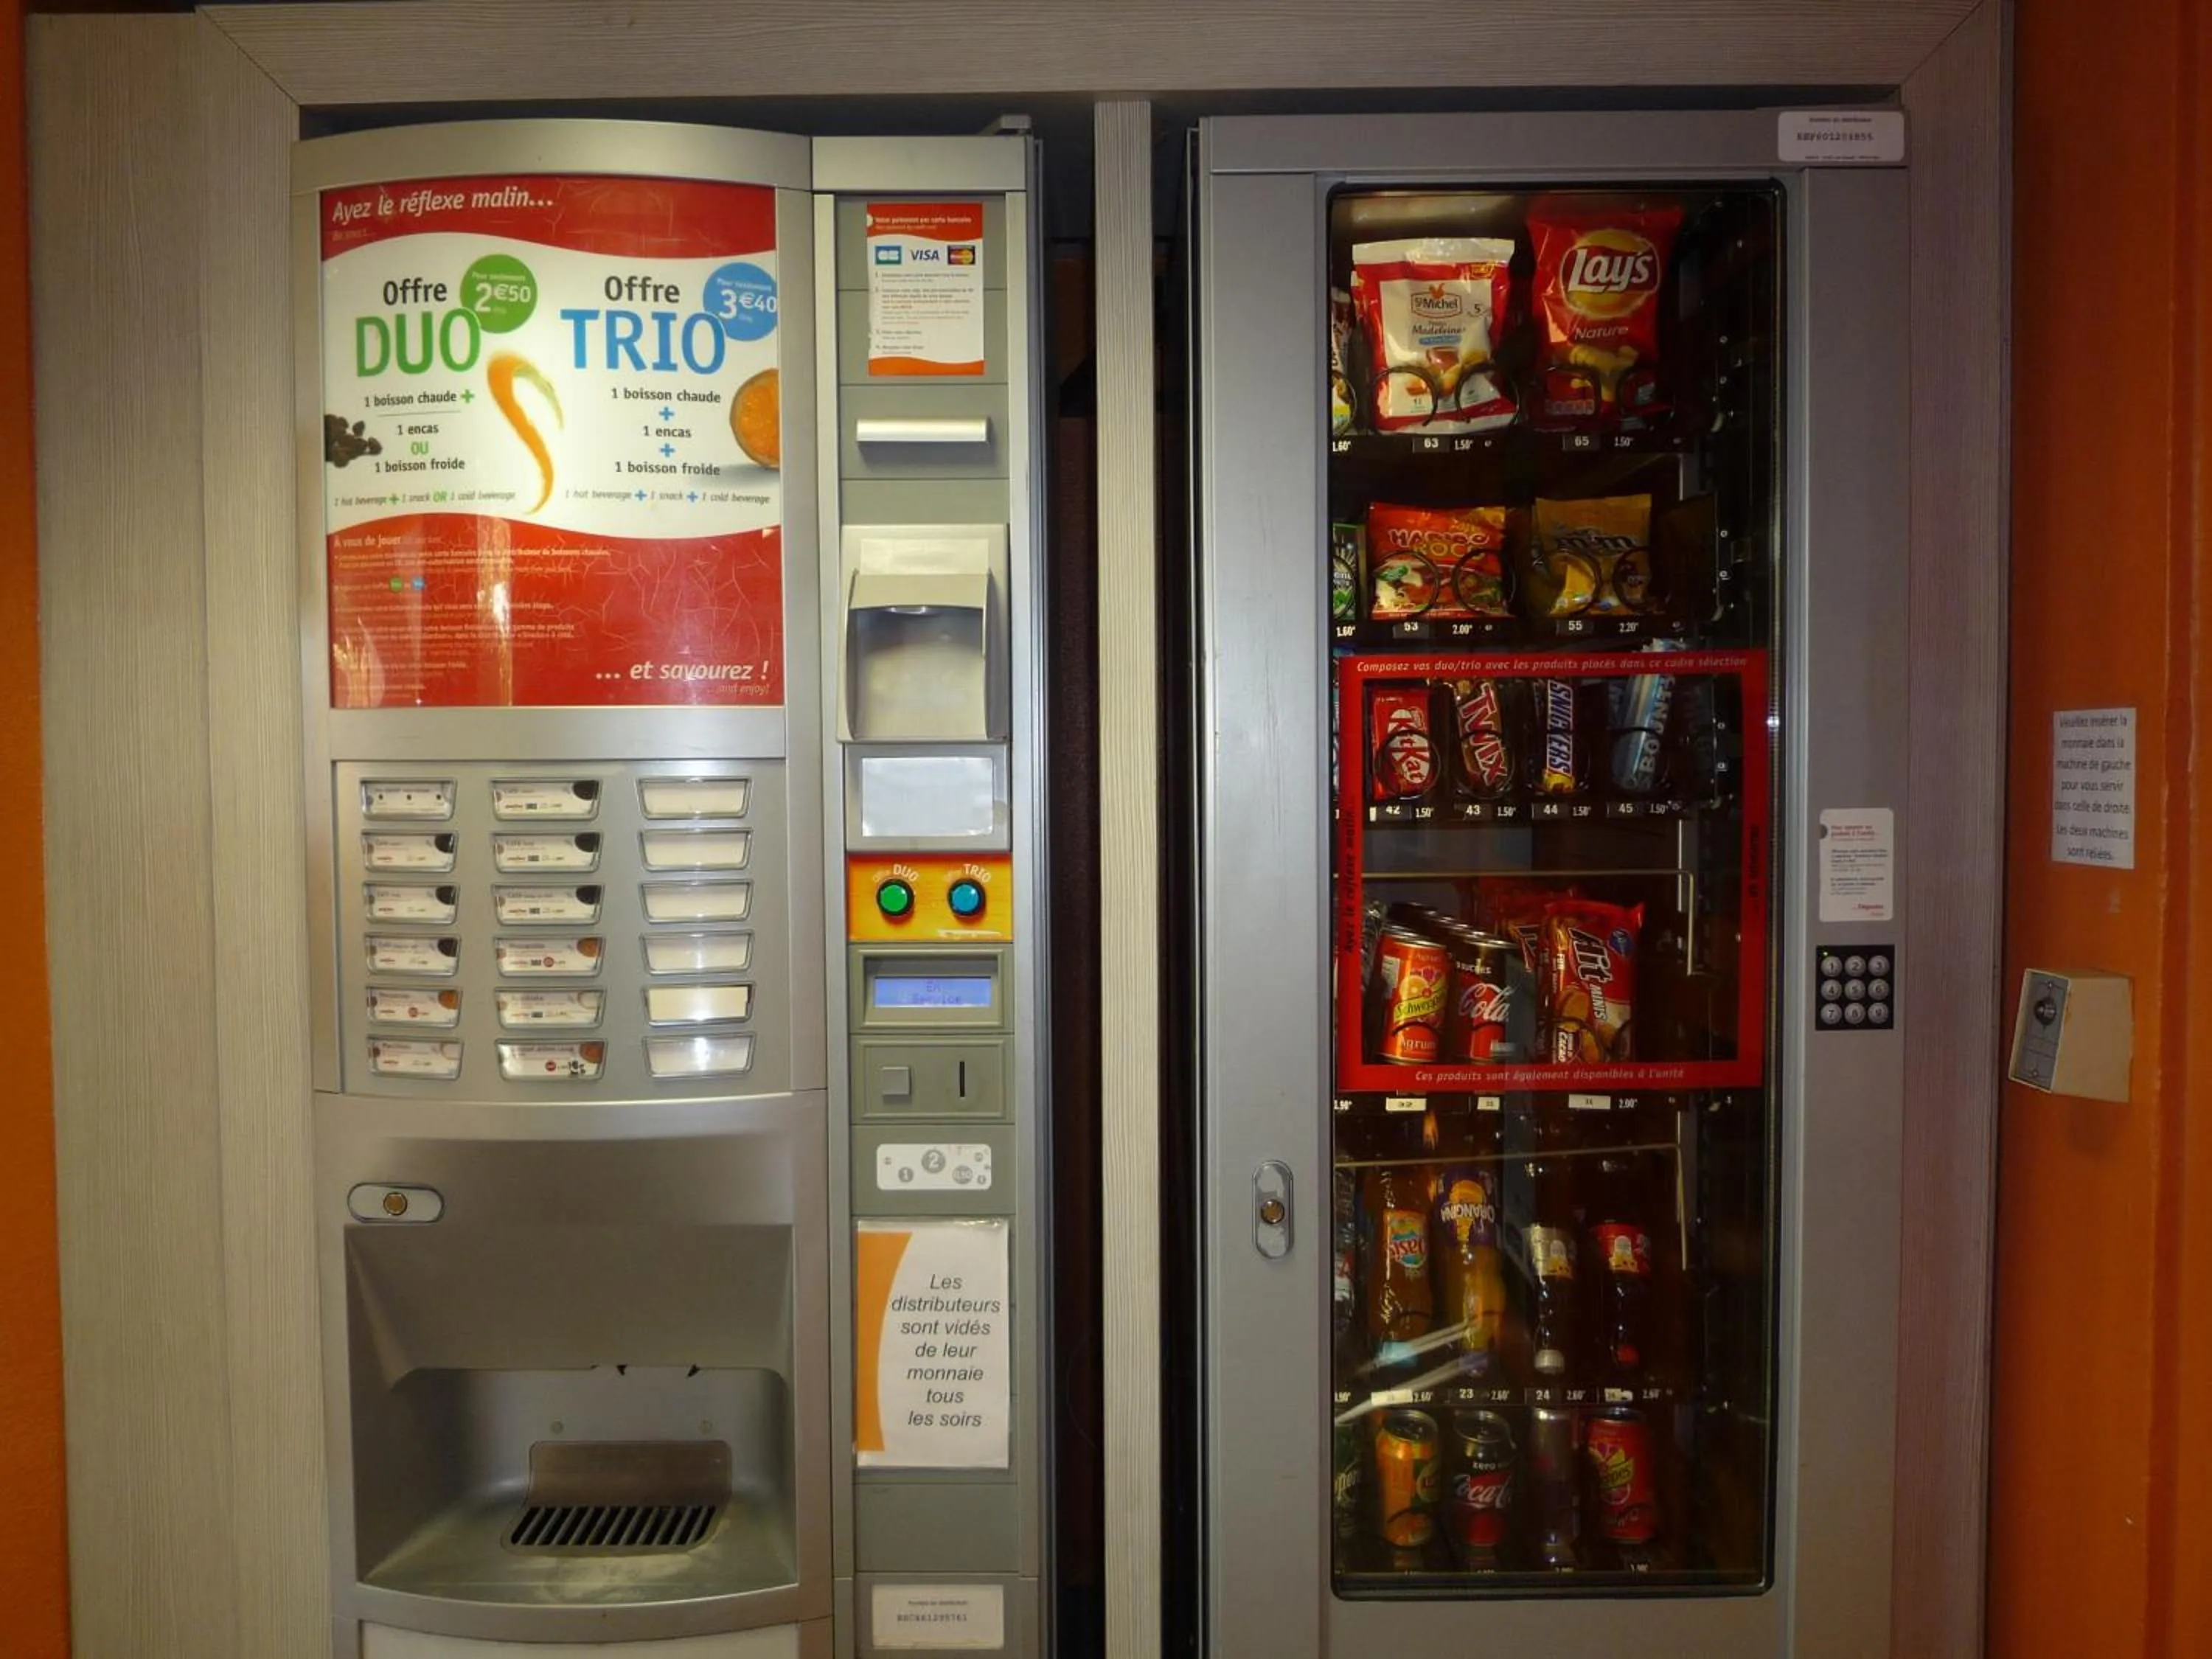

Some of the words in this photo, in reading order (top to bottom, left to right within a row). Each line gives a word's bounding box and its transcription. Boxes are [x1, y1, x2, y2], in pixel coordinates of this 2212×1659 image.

[333, 201, 370, 225] Ayez
[378, 195, 393, 215] le
[399, 190, 465, 216] réflexe
[911, 249, 940, 261] VISA
[383, 278, 447, 305] Offre
[475, 282, 530, 313] 2€50
[605, 276, 680, 303] Offre
[719, 289, 776, 319] 3€40
[355, 307, 480, 378] DUO
[560, 309, 726, 375] TRIO
[365, 396, 370, 407] 1
[374, 394, 413, 406] boisson
[417, 392, 456, 404] chaude
[611, 388, 618, 399] 1
[624, 388, 672, 400] boisson
[676, 389, 720, 403] chaude
[397, 425, 403, 435] 1
[408, 425, 439, 434] encas
[643, 425, 650, 437] 1
[655, 427, 692, 438] encas
[411, 442, 429, 455] OU
[1424, 437, 1439, 449] 63
[375, 462, 380, 473] 1
[385, 459, 426, 473] boisson
[431, 457, 465, 470] froide
[615, 462, 622, 473] 1
[627, 461, 677, 474] boisson
[681, 462, 720, 476] froide
[1403, 622, 1419, 632] 53
[1568, 620, 1583, 631] 55
[630, 661, 653, 680] et
[659, 663, 754, 682] savourez
[761, 661, 769, 681] !
[1357, 661, 1409, 673] Composez
[1434, 660, 1481, 672] duo/trio
[1485, 661, 1509, 670] avec
[1513, 659, 1528, 670] les
[1532, 659, 1578, 672] produits
[1388, 709, 1430, 784] KitKat
[1465, 804, 1481, 815] 43
[1543, 804, 1558, 815] 44
[1618, 802, 1634, 813] 45
[893, 864, 919, 883] DUO
[963, 863, 992, 883] TRIO
[1588, 984, 1608, 1020] MINIS
[1415, 1071, 1433, 1082] Ces
[1436, 1070, 1482, 1083] produits
[1486, 1071, 1510, 1081] sont
[1513, 1069, 1569, 1082] également
[1572, 1068, 1635, 1082] disponibles
[928, 1152, 939, 1169] 2
[930, 1274, 963, 1290] Les
[891, 1297, 1001, 1313] distributeurs
[900, 1321, 939, 1335] sont
[945, 1318, 991, 1335] vidés
[914, 1342, 937, 1358] de
[942, 1343, 978, 1358] leur
[906, 1366, 984, 1381] monnaie
[925, 1388, 964, 1405] tous
[1458, 1388, 1475, 1399] 23
[1535, 1389, 1551, 1400] 24
[908, 1410, 933, 1426] les
[939, 1411, 982, 1427] soirs
